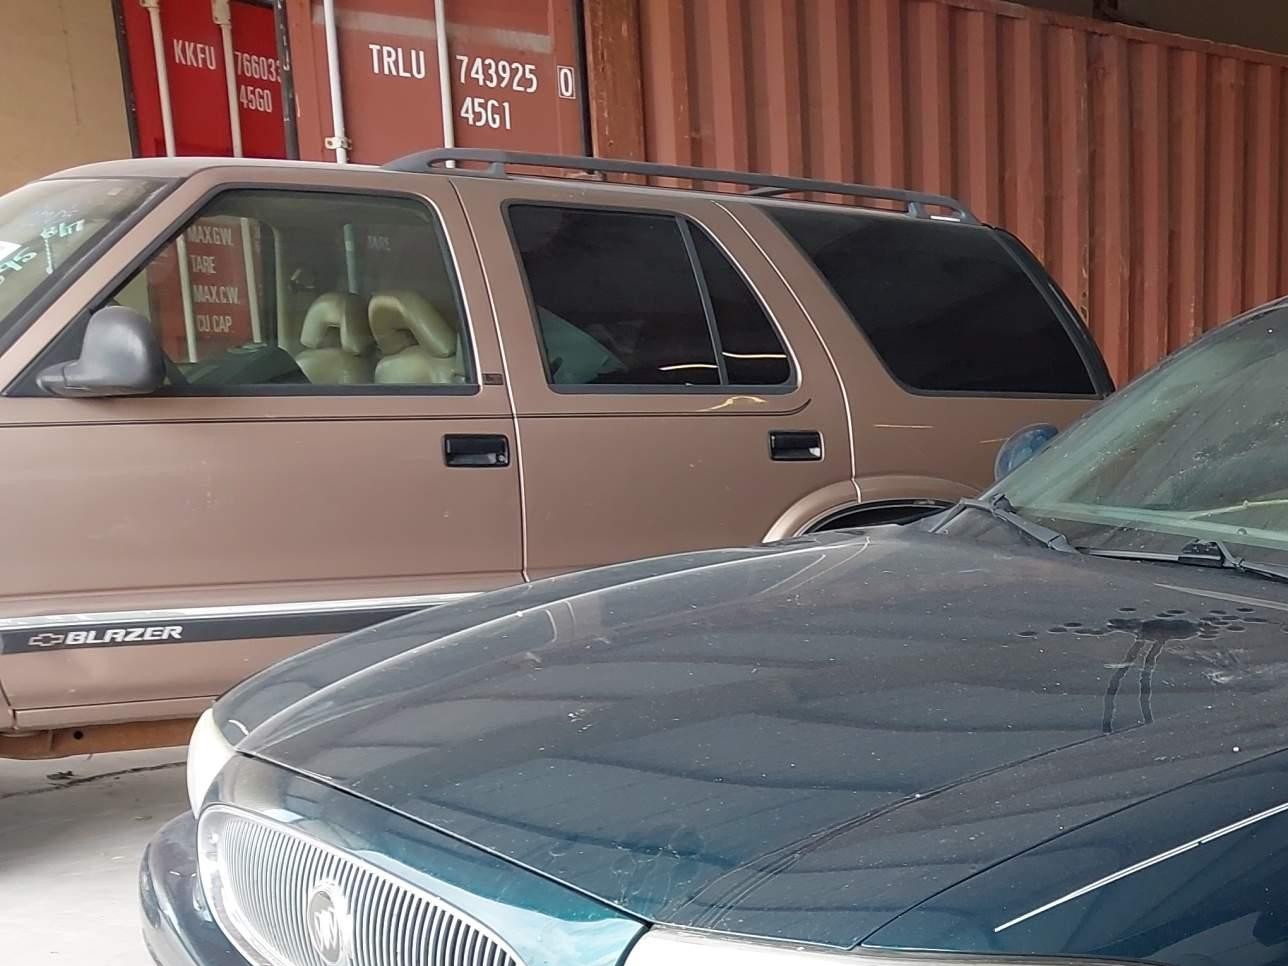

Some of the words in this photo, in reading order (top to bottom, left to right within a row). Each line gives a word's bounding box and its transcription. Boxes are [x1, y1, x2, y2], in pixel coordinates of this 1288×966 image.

[173, 39, 217, 70] KKFU
[368, 44, 426, 79] TRLU
[456, 55, 538, 93] 743925
[460, 96, 512, 130] 45G1
[189, 254, 217, 274] TARE
[64, 625, 183, 645] BLAZER
